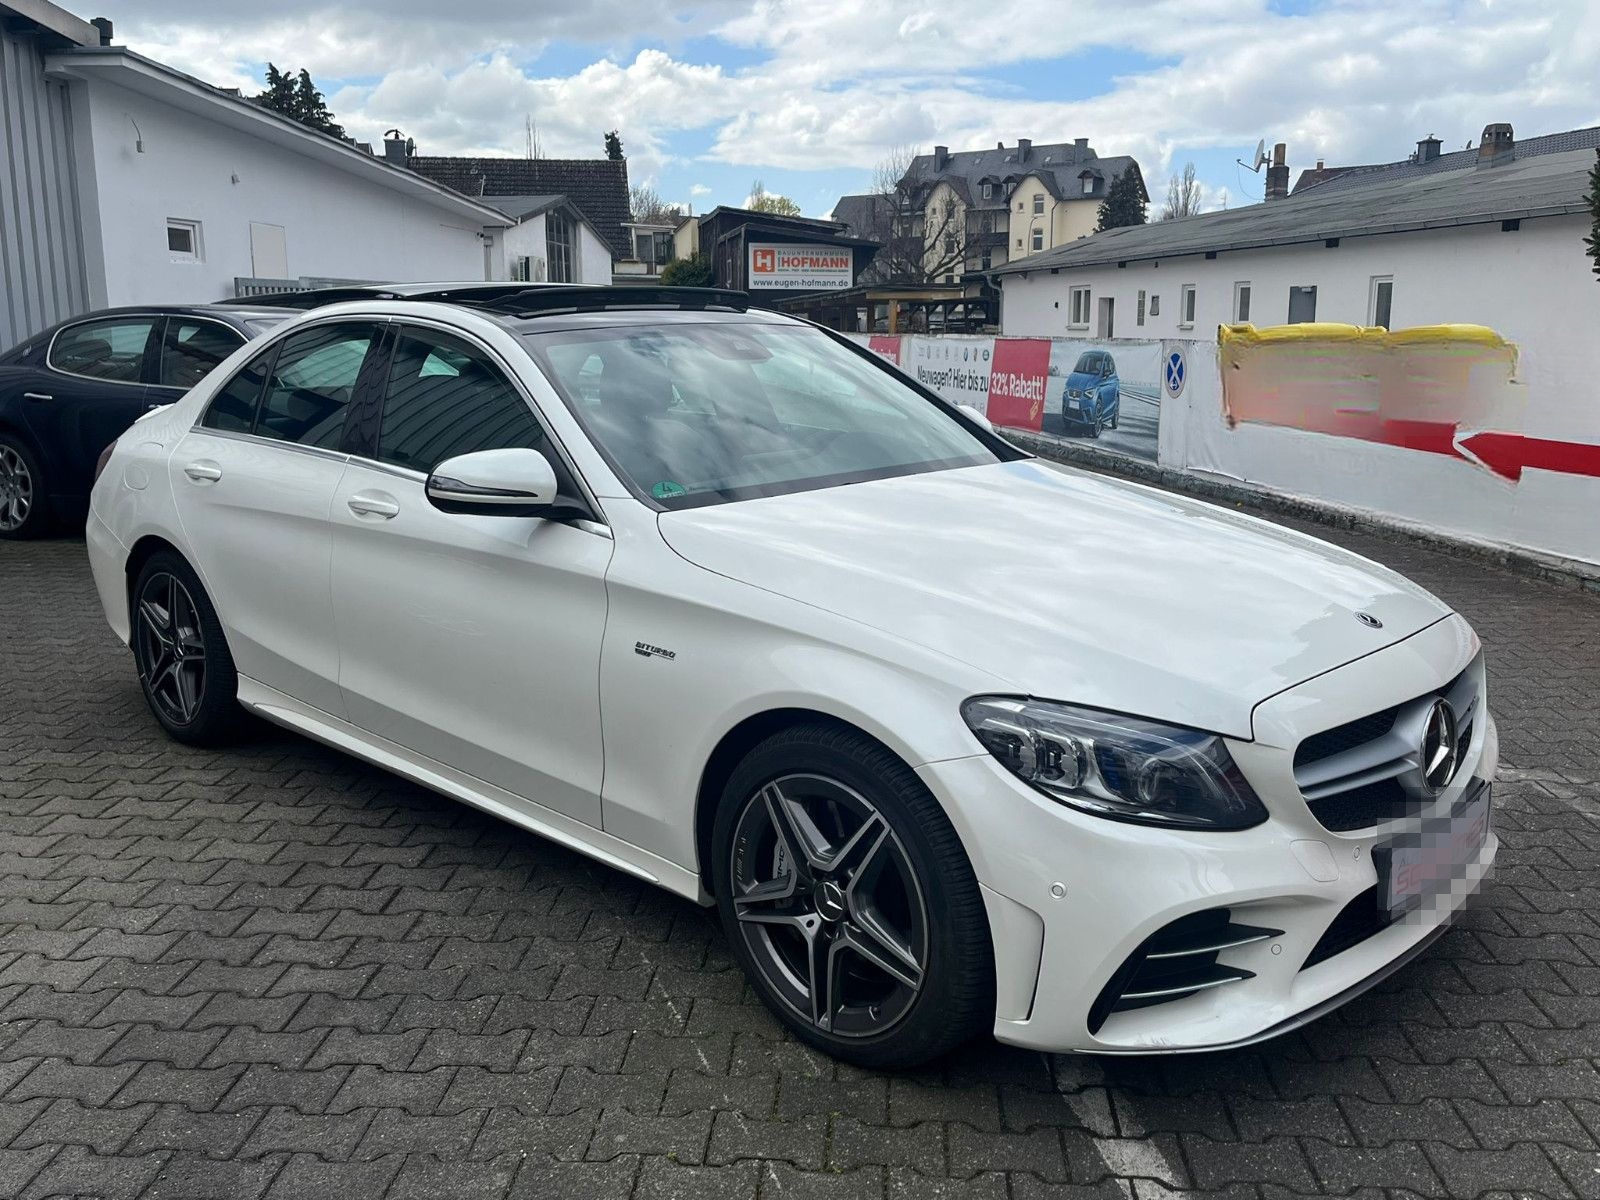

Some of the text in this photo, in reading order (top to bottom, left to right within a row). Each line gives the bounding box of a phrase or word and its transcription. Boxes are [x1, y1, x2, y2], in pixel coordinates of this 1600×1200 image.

[781, 257, 849, 268] HOFMANN
[753, 279, 849, 288] www.eugen-hofmann.de
[917, 365, 1044, 400] Neuwagen? Hier bis zu 32% Rabatt!
[635, 641, 676, 658] BITURBO
